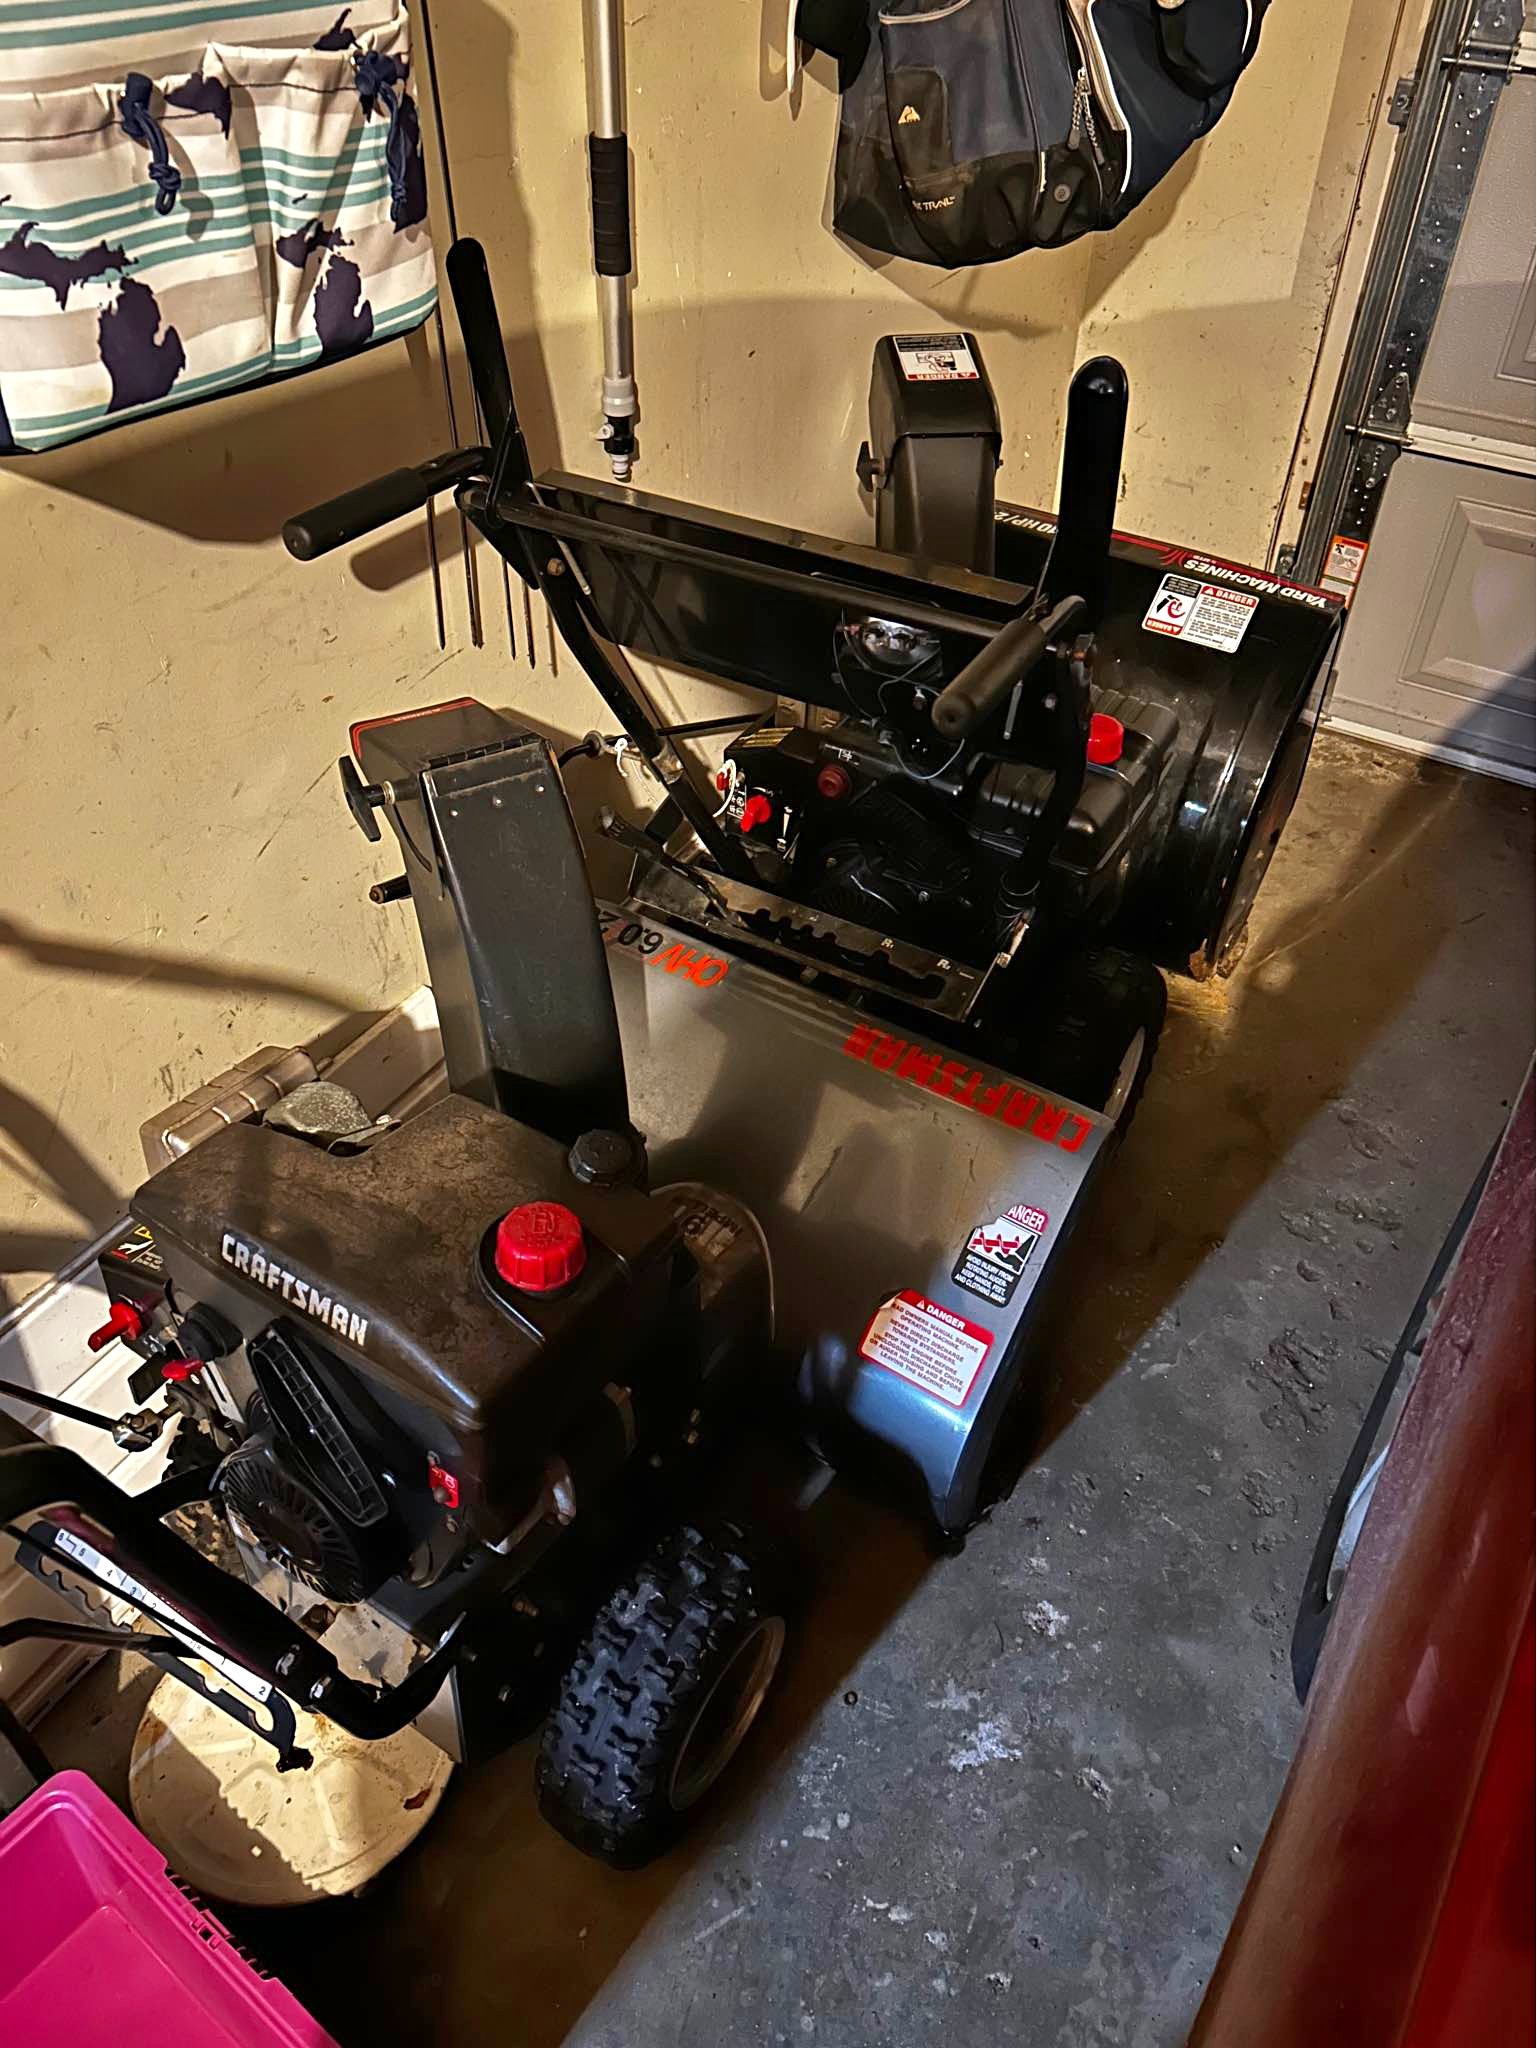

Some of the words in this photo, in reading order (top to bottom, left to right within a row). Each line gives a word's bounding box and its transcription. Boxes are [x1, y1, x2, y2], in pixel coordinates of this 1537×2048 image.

[1184, 559, 1279, 594] MACHINES
[1216, 590, 1253, 606] DANGER
[1280, 587, 1326, 608] YARD
[1147, 620, 1173, 631] DANGER
[650, 943, 728, 987] OHV
[840, 1022, 1094, 1154] CRAFTSMAN
[1008, 1205, 1046, 1230] ANGER
[955, 1273, 967, 1283] AND
[961, 1268, 975, 1279] KEEP
[998, 1270, 1014, 1282] FROM
[222, 1234, 368, 1346] CRAFTSMAN
[899, 1315, 932, 1335] OPERATING
[926, 1305, 966, 1330] DANGER
[889, 1319, 909, 1332] NEVER
[910, 1330, 930, 1344] DIRECT
[930, 1341, 964, 1362] DISCHARGE
[891, 1327, 918, 1344] TOWARDS
[884, 1332, 899, 1342] STOP
[900, 1341, 911, 1349] THE
[911, 1347, 933, 1362] ENGINE
[934, 1360, 958, 1375] BEFORE
[955, 1338, 979, 1353] BEFORE
[905, 1365, 916, 1374] THE
[925, 1369, 938, 1379] AND
[105, 1569, 114, 1578] 4
[128, 1586, 138, 1597] 3
[258, 1685, 268, 1696] 2
